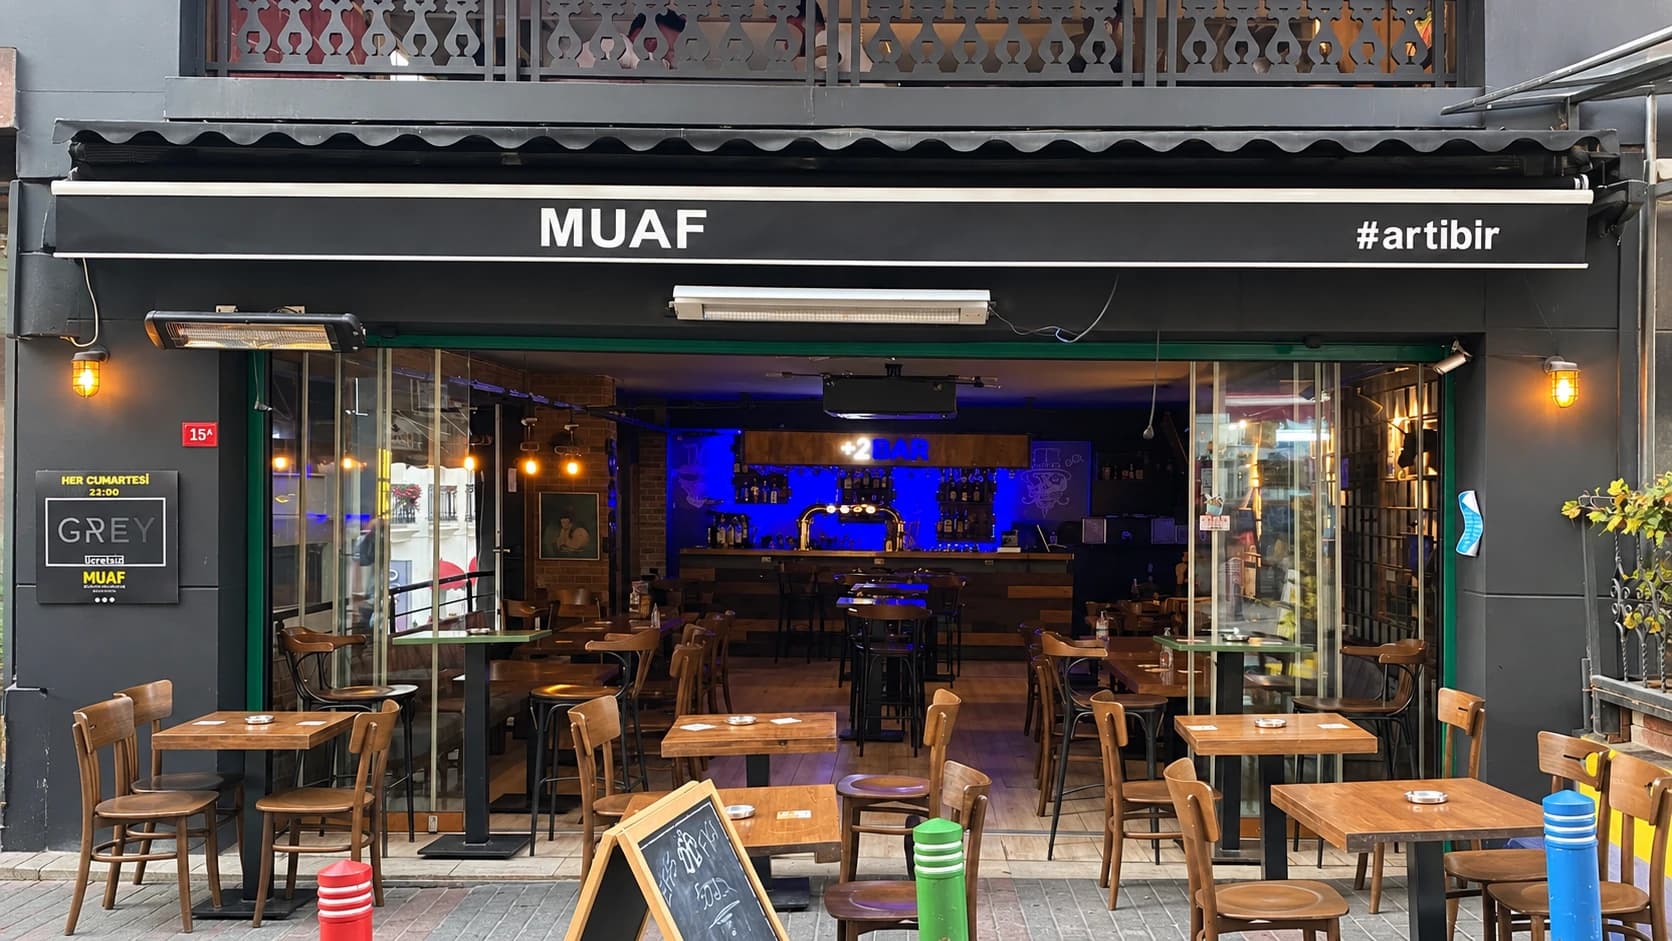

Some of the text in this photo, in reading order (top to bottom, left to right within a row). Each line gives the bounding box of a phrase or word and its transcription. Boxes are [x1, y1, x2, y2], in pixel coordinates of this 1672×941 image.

[540, 207, 708, 249] MUAF
[1356, 219, 1500, 250] #artibir
[61, 473, 149, 485] HER CUMARTESİ
[89, 488, 119, 496] 22:00
[58, 517, 155, 543] GREY
[83, 571, 126, 584] MUAF
